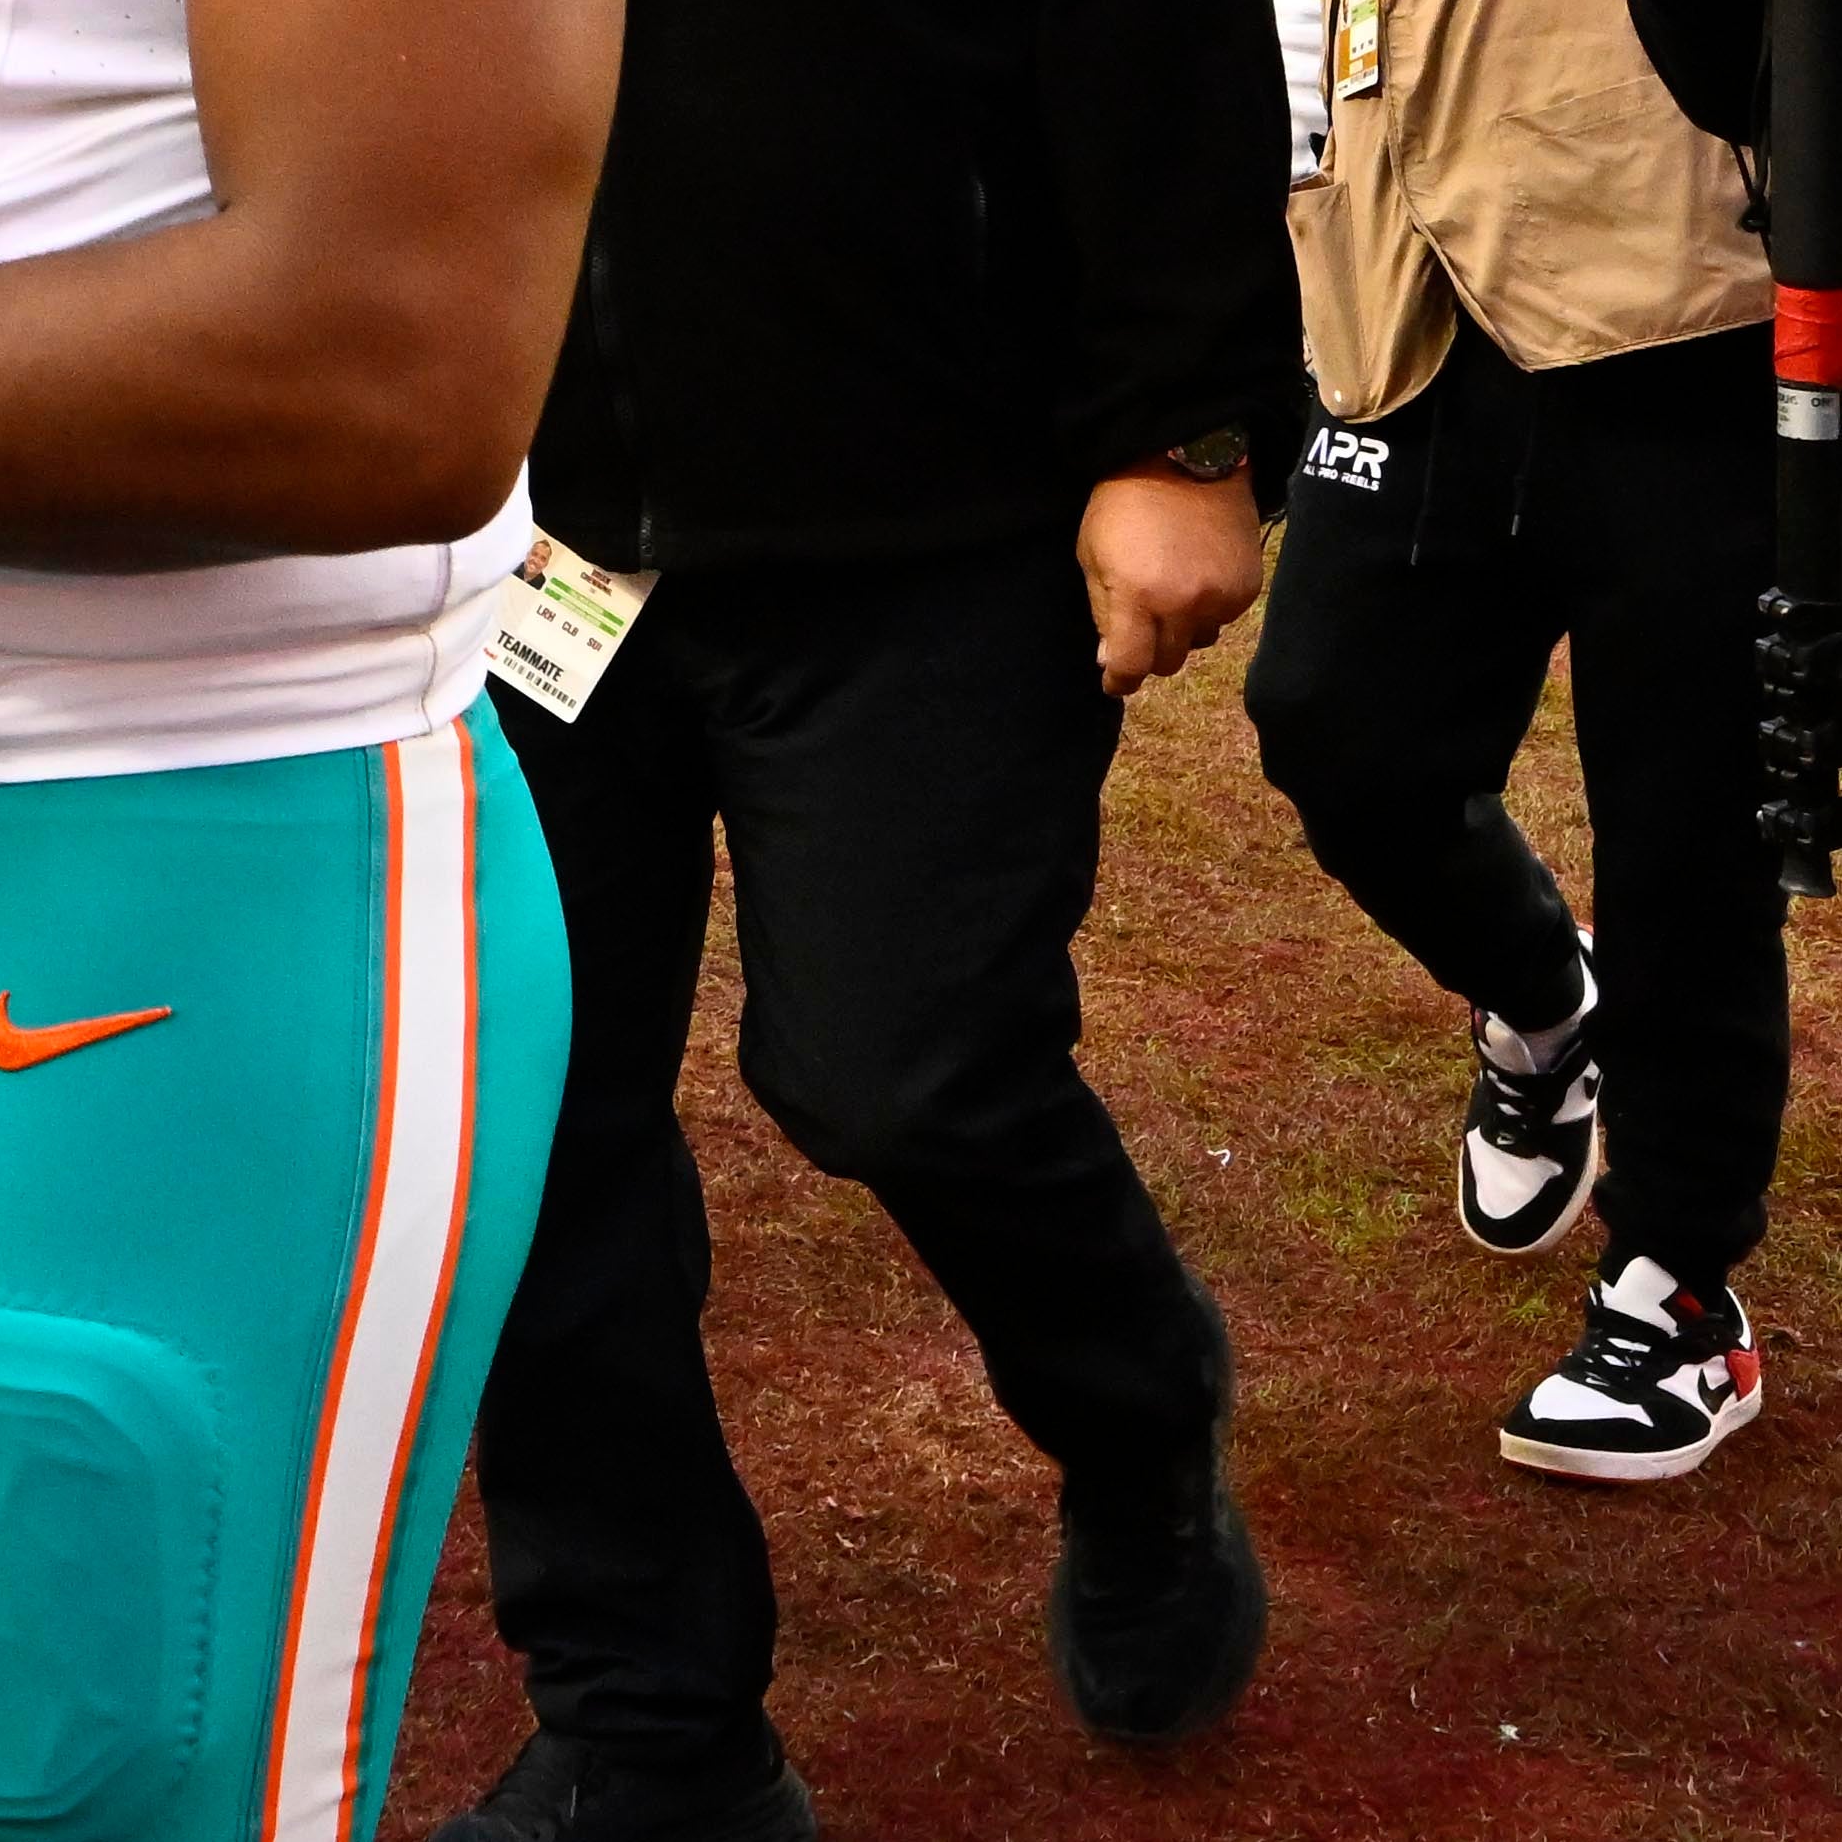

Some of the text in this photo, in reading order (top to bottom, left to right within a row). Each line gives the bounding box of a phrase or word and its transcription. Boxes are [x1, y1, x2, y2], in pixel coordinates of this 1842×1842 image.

[1307, 427, 1390, 479] APR
[1341, 471, 1381, 491] REELS
[497, 629, 565, 683] TEAMMATE
